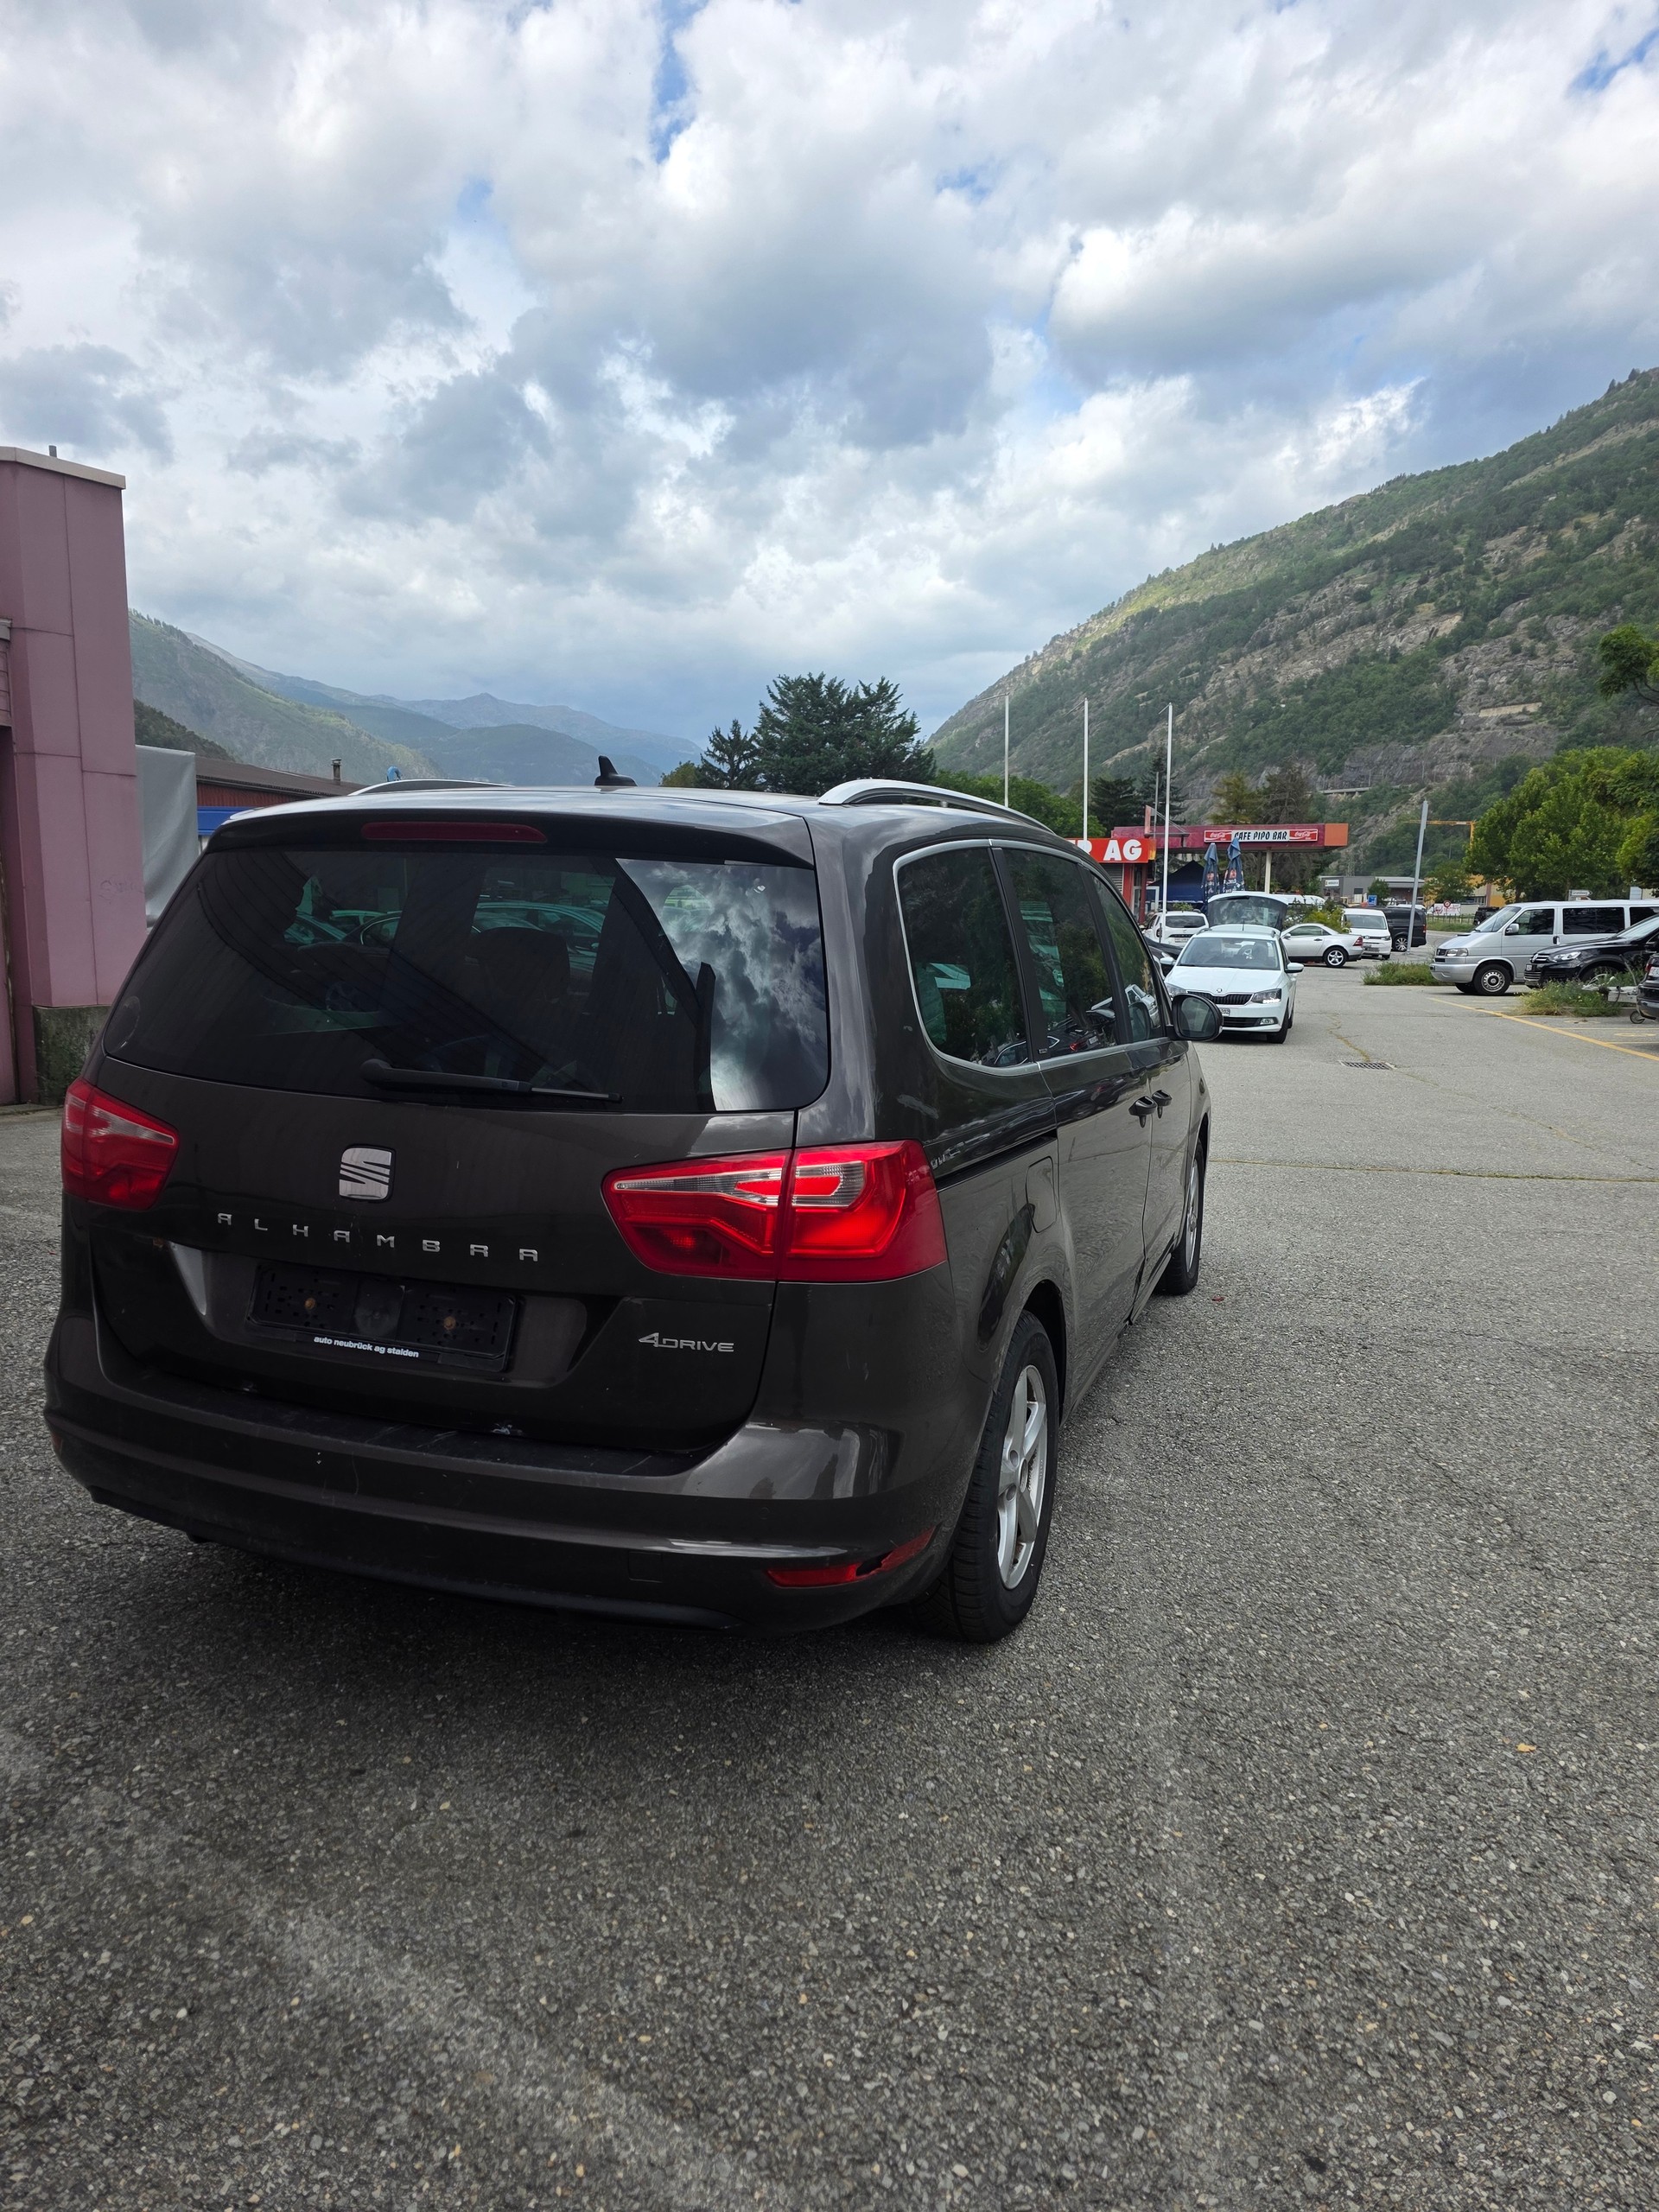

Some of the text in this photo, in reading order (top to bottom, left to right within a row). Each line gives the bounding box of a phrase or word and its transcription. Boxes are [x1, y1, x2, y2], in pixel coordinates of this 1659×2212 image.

[1235, 830, 1287, 841] CAFE PIPO BAR
[1103, 839, 1142, 861] AG
[218, 1212, 538, 1262] ALHAMBRA
[314, 1336, 419, 1357] auto neubrück ag stalden
[639, 1332, 734, 1352] 4DRIVE
